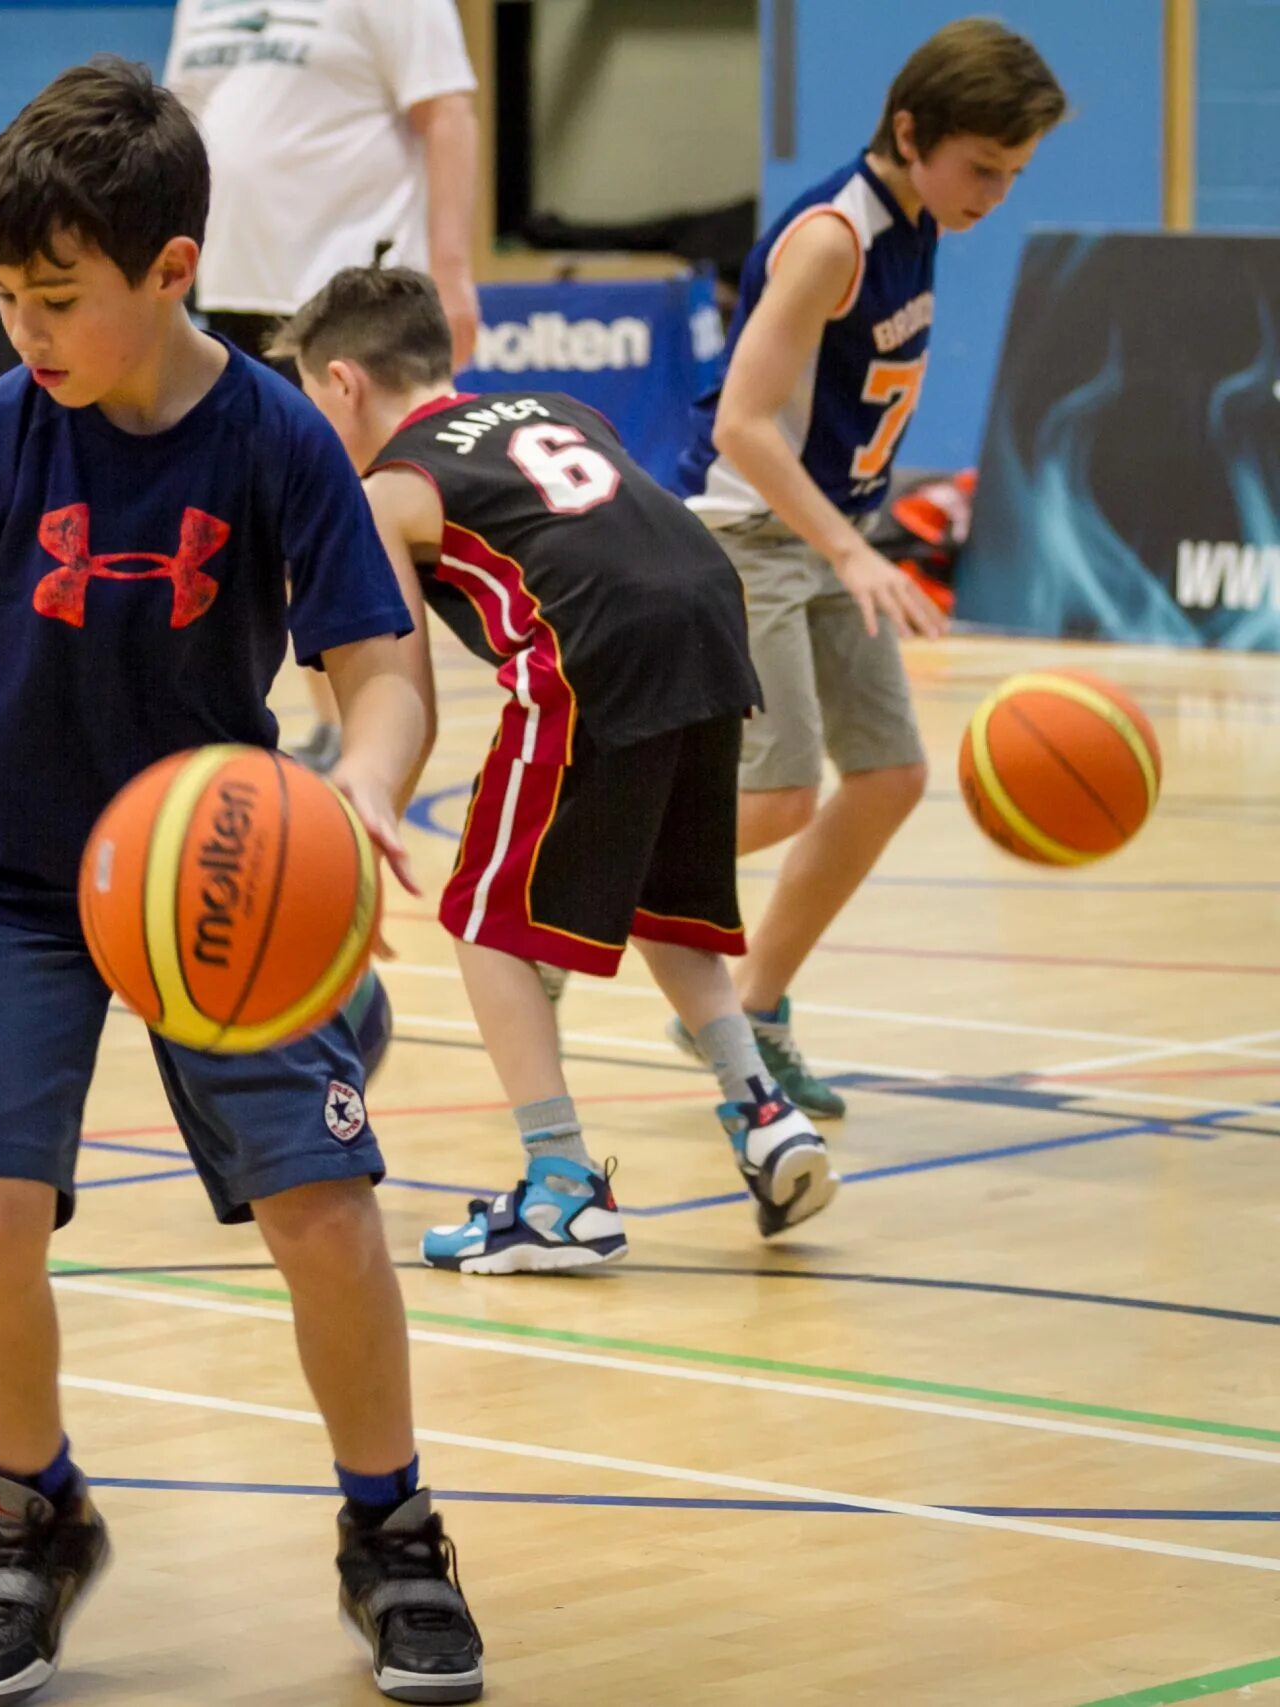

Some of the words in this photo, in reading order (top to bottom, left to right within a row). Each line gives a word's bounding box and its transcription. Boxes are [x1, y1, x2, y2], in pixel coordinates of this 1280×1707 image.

[435, 398, 551, 455] JAMES
[849, 352, 928, 479] 7
[506, 422, 624, 515] 6
[1176, 538, 1280, 611] WW
[194, 781, 257, 967] molten
